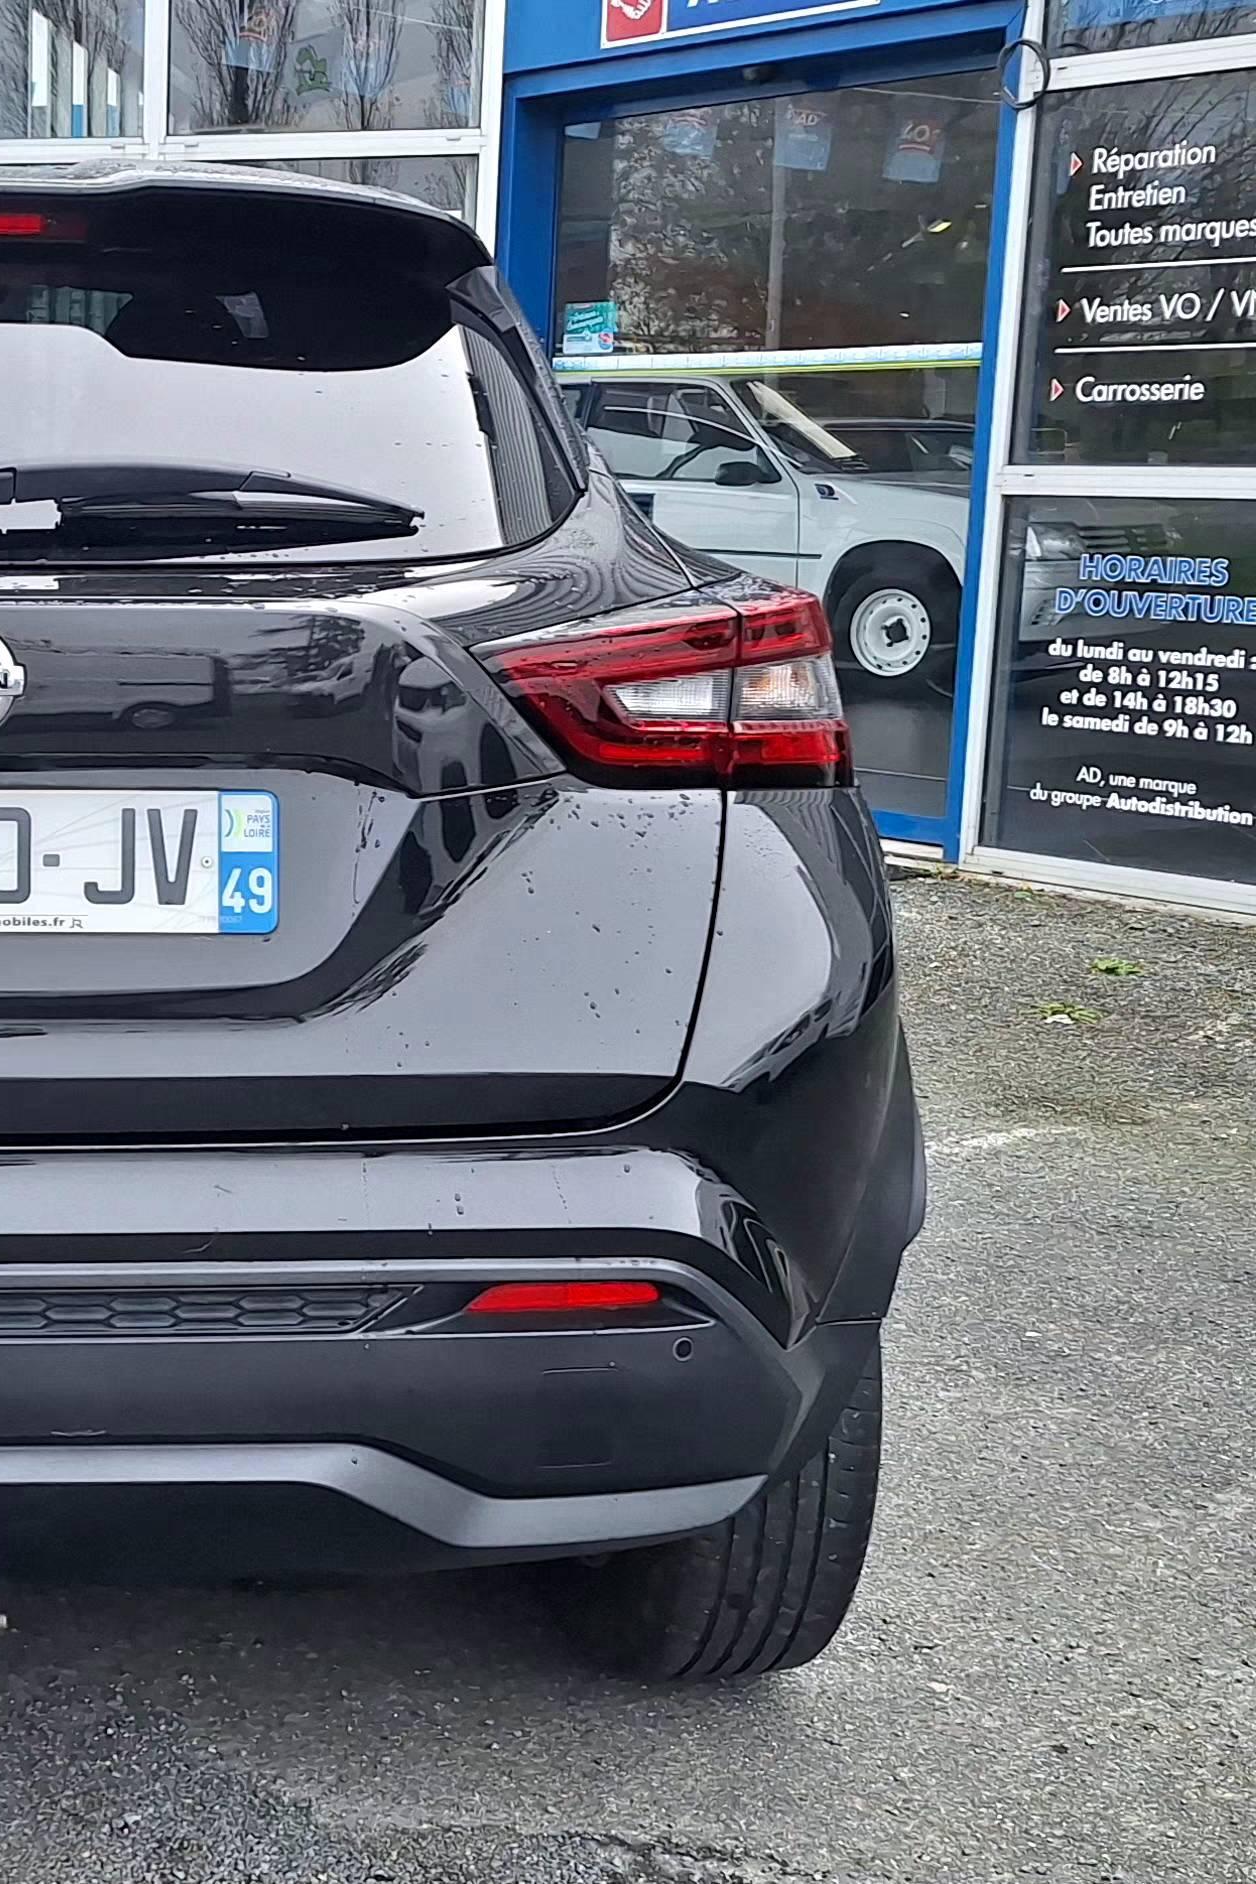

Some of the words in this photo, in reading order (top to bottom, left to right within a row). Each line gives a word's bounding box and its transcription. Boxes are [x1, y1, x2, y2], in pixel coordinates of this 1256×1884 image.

[1092, 140, 1216, 179] Réparation
[1088, 181, 1186, 211] Entretien
[1086, 222, 1153, 248] Toutes
[1160, 218, 1256, 247] marques
[1080, 298, 1152, 323] Ventes
[1159, 292, 1201, 320] VO
[1205, 288, 1224, 322] /
[1075, 375, 1205, 402] Carrosserie
[1079, 554, 1229, 586] HORAIRES
[1055, 588, 1256, 625] D'OUVERTURE
[1048, 638, 1073, 657] du
[1077, 639, 1124, 660] lundi
[1128, 649, 1153, 662] au
[1158, 647, 1246, 669] vendredi
[1079, 663, 1103, 683] de
[1107, 666, 1132, 685] 8h
[1137, 668, 1151, 687] à
[1157, 670, 1219, 692] 12h15
[1060, 689, 1079, 704] et
[1083, 687, 1107, 707] de
[1113, 690, 1148, 710] 14h
[1152, 693, 1167, 712] à
[1174, 696, 1237, 718] 18h30
[1042, 707, 1059, 726] le
[1062, 714, 1130, 733] samedi
[1134, 716, 1159, 735] de
[1162, 719, 1189, 738] 9h
[1193, 721, 1208, 740] à
[1215, 724, 1253, 744] 12h
[1076, 766, 1105, 787] AD,
[1109, 774, 1136, 788] une
[1139, 778, 1197, 798] marque
[247, 814, 271, 824] PAYS
[1030, 782, 1048, 800] du
[1051, 791, 1102, 809] groupe
[1105, 793, 1253, 826] Autodistribution
[244, 828, 271, 838] LOIRE
[222, 867, 273, 914] 49
